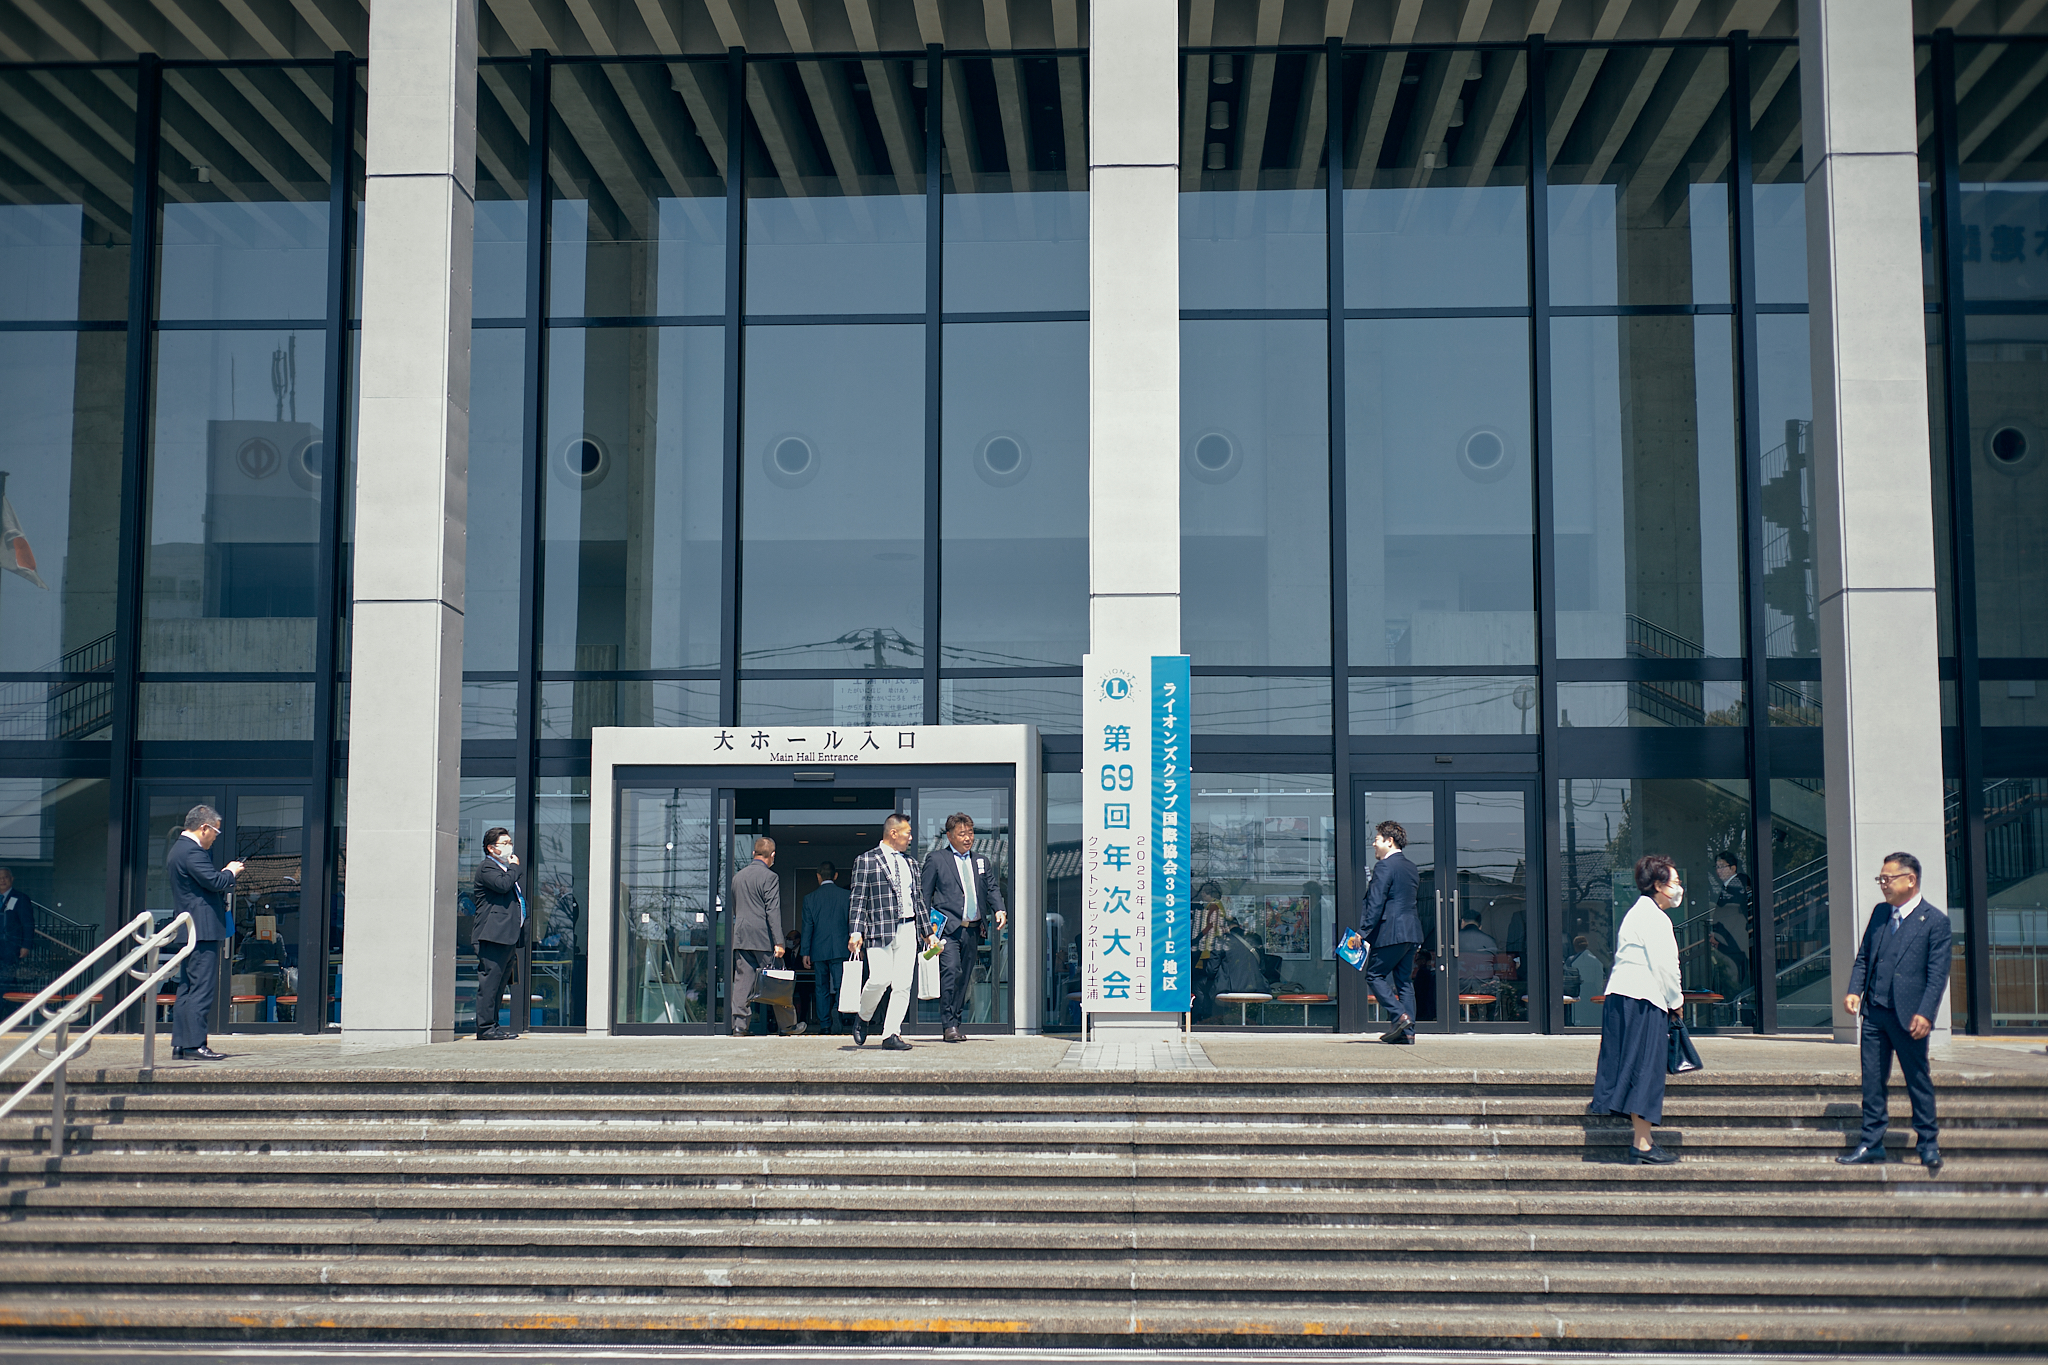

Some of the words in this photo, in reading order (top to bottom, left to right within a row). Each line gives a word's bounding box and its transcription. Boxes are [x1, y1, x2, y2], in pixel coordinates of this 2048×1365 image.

[714, 730, 915, 751] 大ホール入口
[769, 752, 793, 762] Main
[796, 752, 815, 762] Hall
[817, 752, 858, 762] Entrance
[1101, 724, 1134, 1000] 第69回年次大会
